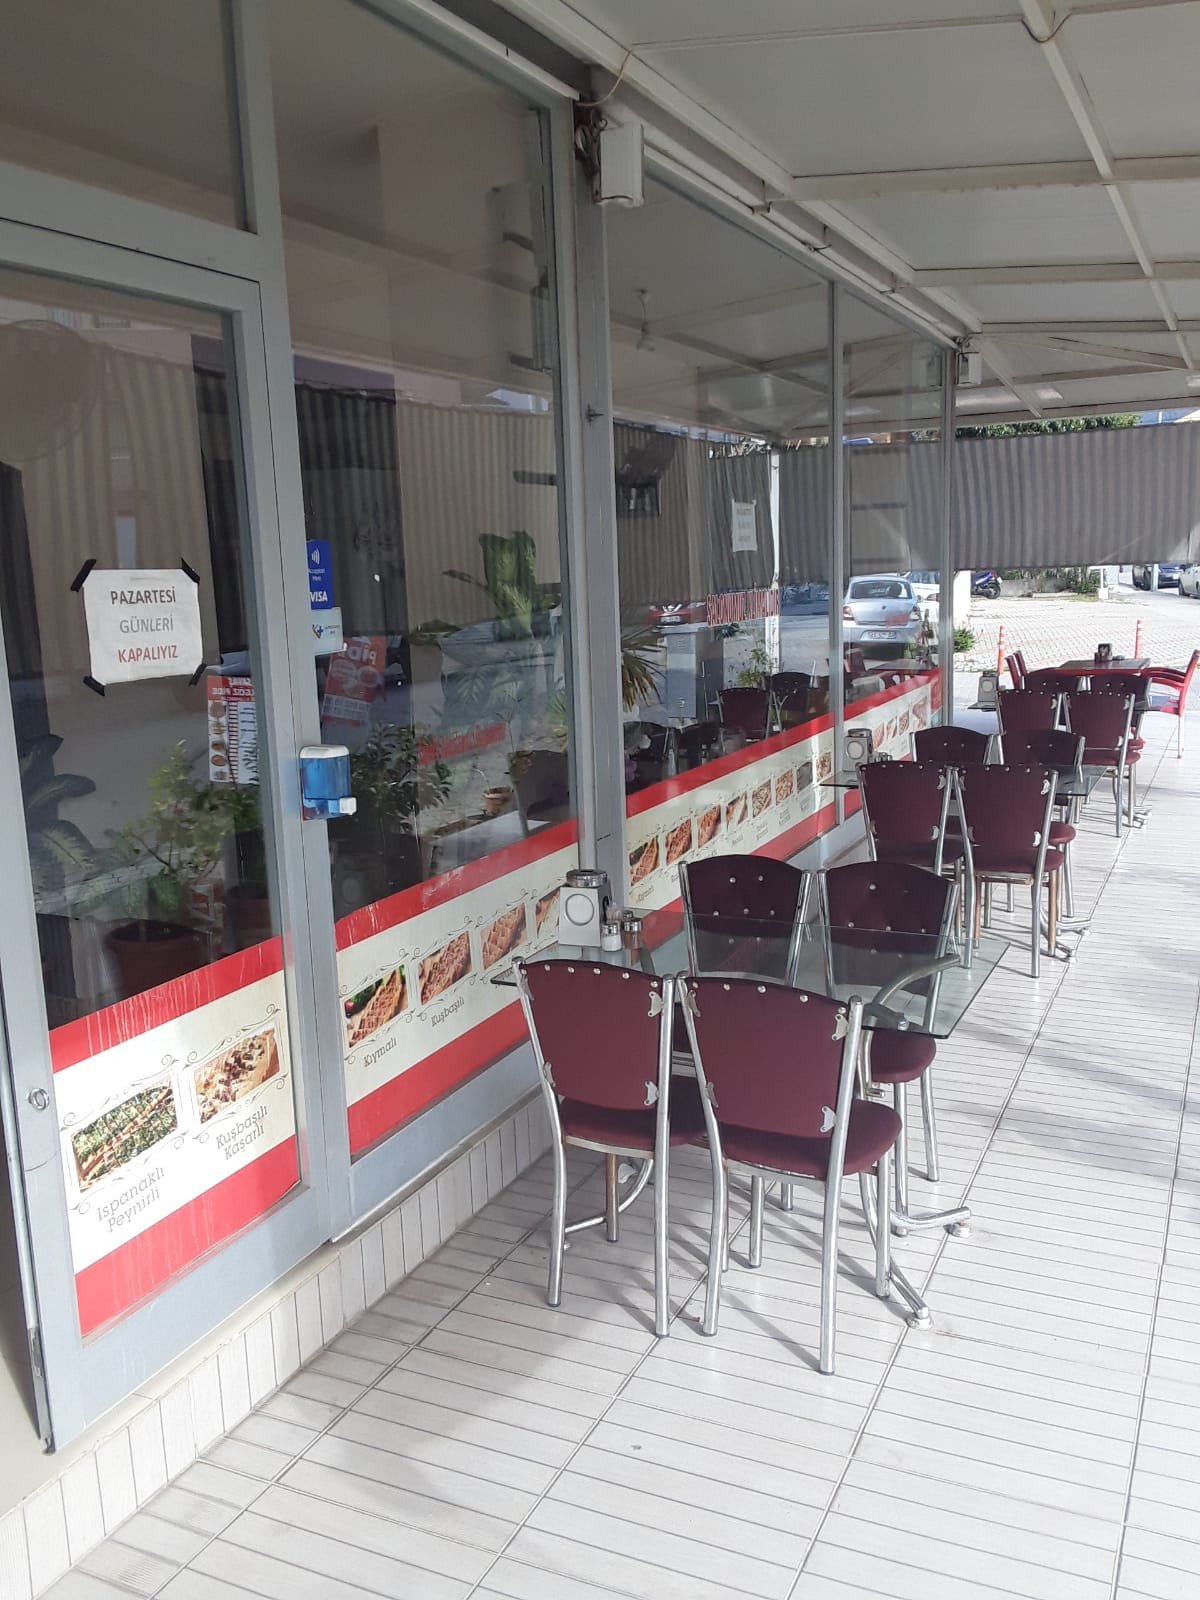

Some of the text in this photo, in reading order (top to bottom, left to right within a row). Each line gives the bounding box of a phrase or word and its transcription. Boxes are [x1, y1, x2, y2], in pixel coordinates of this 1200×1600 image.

[110, 586, 176, 605] PAZARTESİ
[309, 591, 328, 602] VISA
[119, 615, 174, 633] GÜNLERİ
[118, 645, 179, 663] KAPALIYIZ
[363, 1037, 397, 1067] Kıymalı
[216, 1105, 268, 1150] Kuşbaşılı
[224, 1122, 264, 1160] Kaşarlı
[108, 1186, 160, 1232] Peynirli
